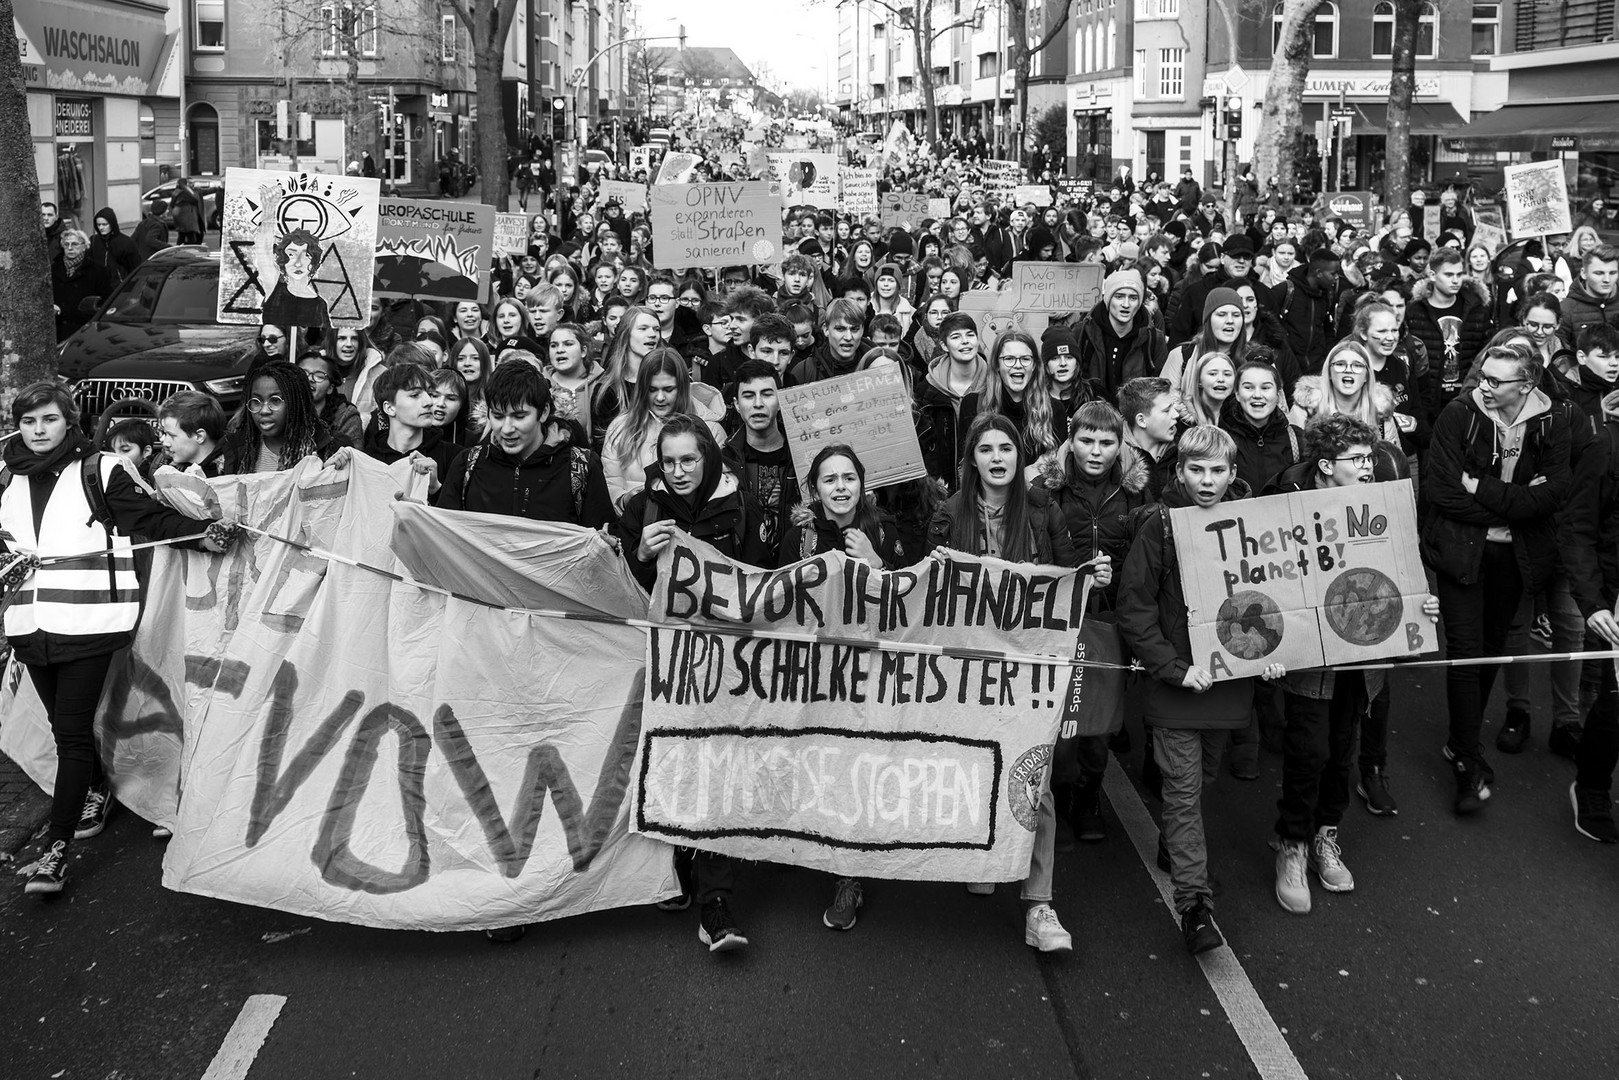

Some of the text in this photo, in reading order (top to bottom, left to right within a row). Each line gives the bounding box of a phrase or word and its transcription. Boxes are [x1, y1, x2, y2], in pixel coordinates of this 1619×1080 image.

[43, 26, 139, 67] WASCHSALON
[56, 102, 91, 118] DERUNGS-
[1513, 188, 1535, 199] FIGHT
[675, 206, 754, 226] expandieren
[442, 223, 457, 235] for
[671, 220, 765, 240] statt Straßen
[685, 241, 746, 258] sanieren!
[1027, 266, 1055, 280] Wo
[1023, 282, 1056, 291] mein
[784, 384, 842, 405] WARUM
[824, 402, 849, 417] eine
[799, 427, 821, 442] die
[829, 424, 843, 435] es
[1204, 504, 1388, 562] There is No
[1223, 543, 1347, 598] planet B!
[666, 545, 1097, 632] BEVOR IHR HANDELT
[1405, 622, 1424, 651] B
[650, 625, 725, 705] WIRD
[729, 635, 868, 703] SCHALKE
[1210, 651, 1233, 679] A
[839, 750, 983, 830] STOPPEN
